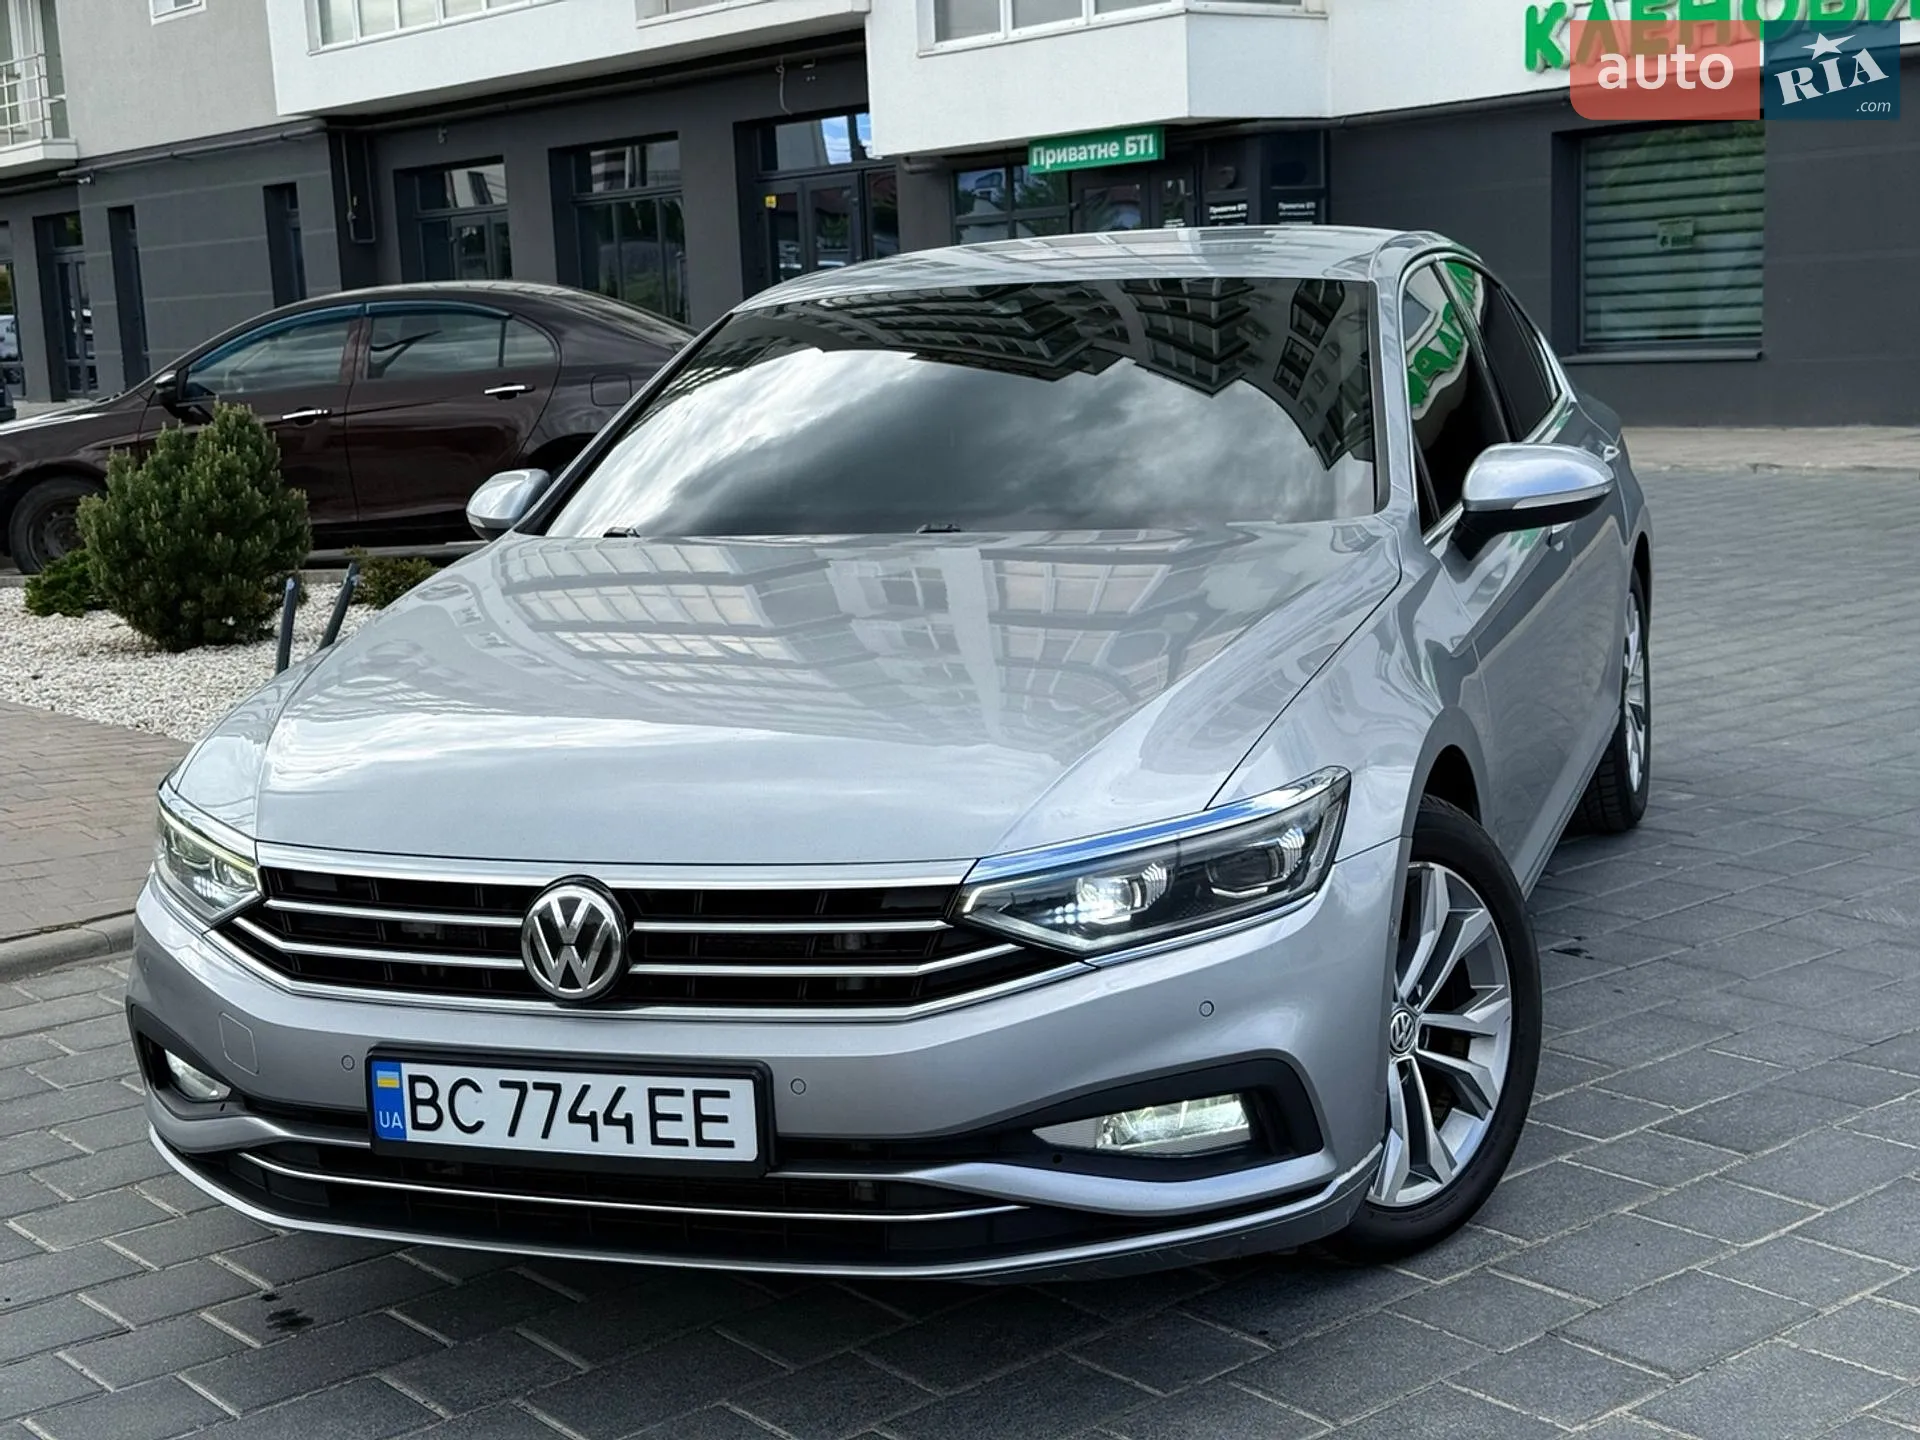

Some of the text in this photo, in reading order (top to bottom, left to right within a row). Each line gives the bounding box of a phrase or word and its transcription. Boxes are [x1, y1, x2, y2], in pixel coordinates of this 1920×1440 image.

[1031, 133, 1154, 169] Приватне БТІ
[525, 888, 618, 997] VW
[379, 1111, 403, 1128] UA
[408, 1074, 735, 1148] BC 7744 EE
